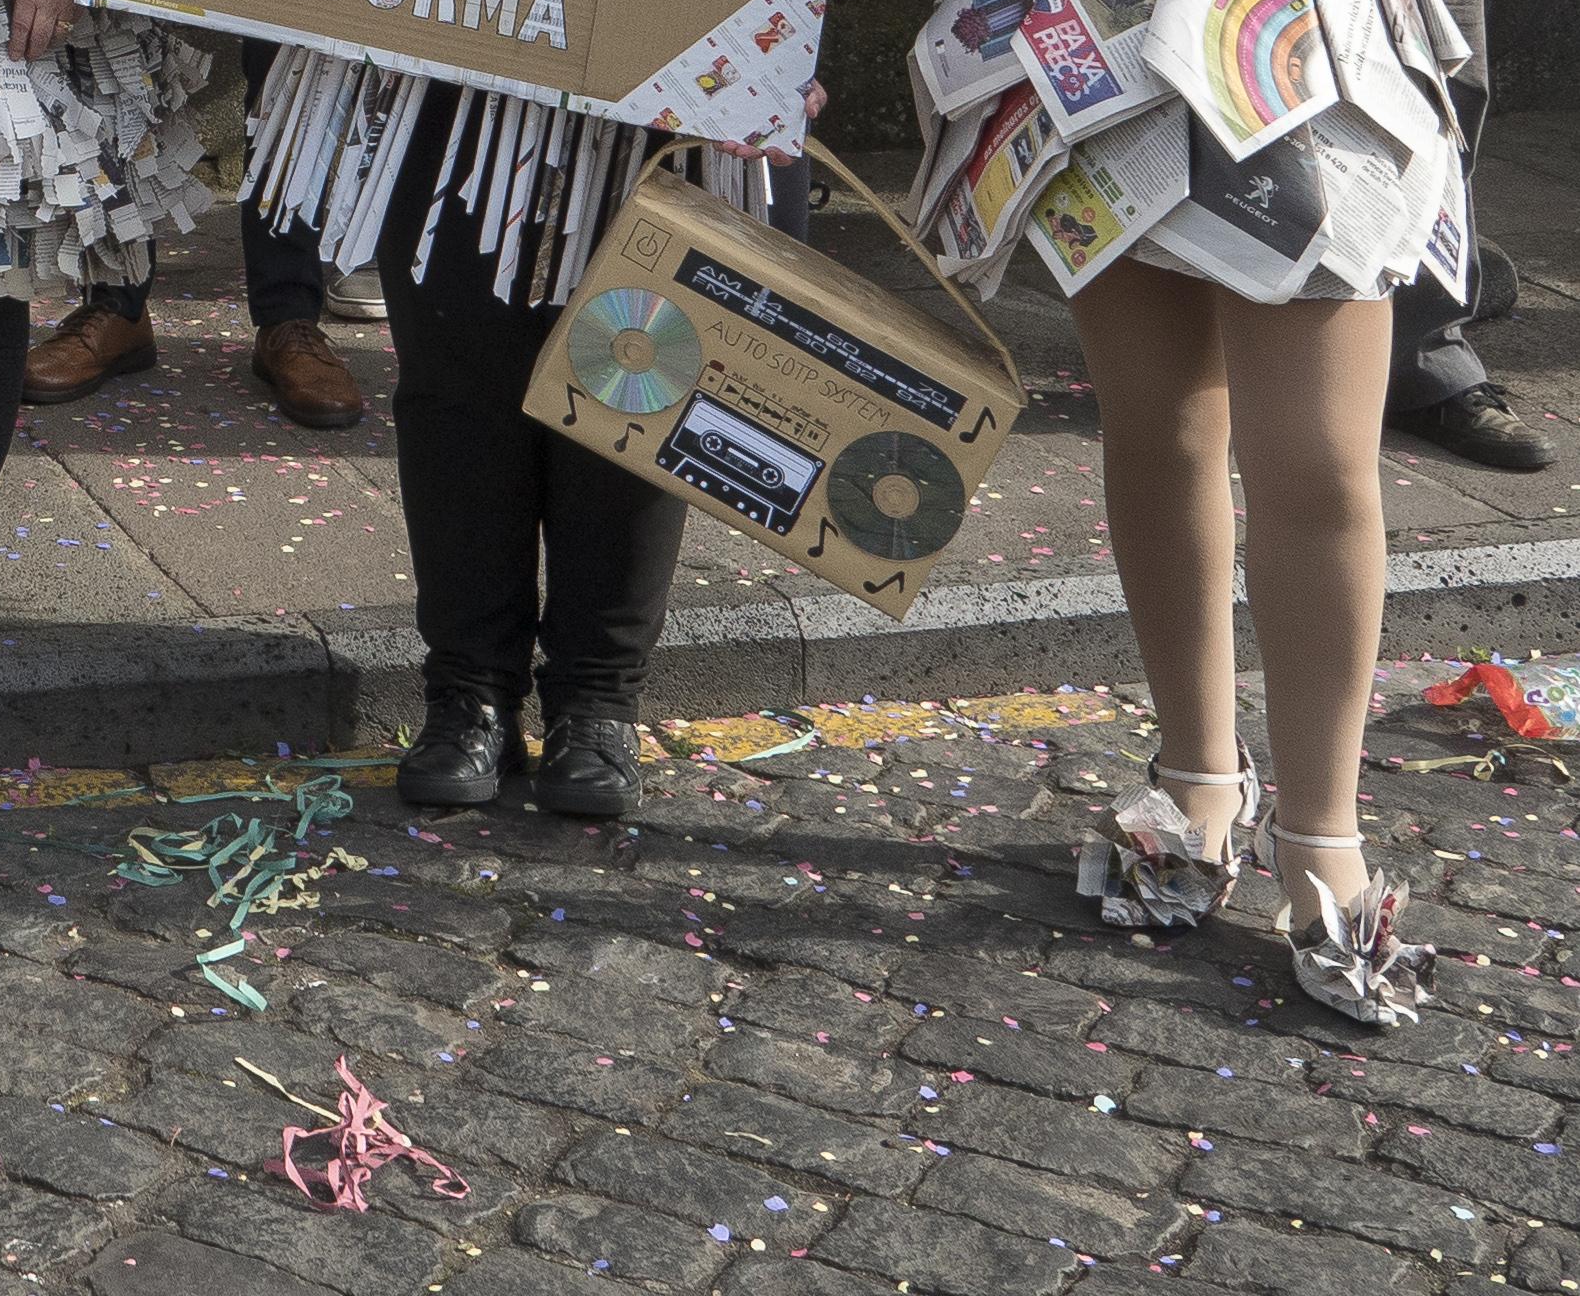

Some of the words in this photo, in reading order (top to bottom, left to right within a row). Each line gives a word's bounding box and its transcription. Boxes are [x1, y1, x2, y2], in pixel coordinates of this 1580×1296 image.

[1224, 191, 1280, 228] PEUGEOT
[691, 274, 730, 301] FM
[699, 264, 742, 291] AM
[705, 319, 769, 361] AUTO
[770, 352, 820, 384] SOTP
[818, 378, 892, 427] SYSTEM
[793, 331, 828, 355] 90
[844, 359, 878, 384] 92
[895, 388, 929, 411] 94
[825, 332, 860, 356] 60
[918, 381, 948, 404] 70
